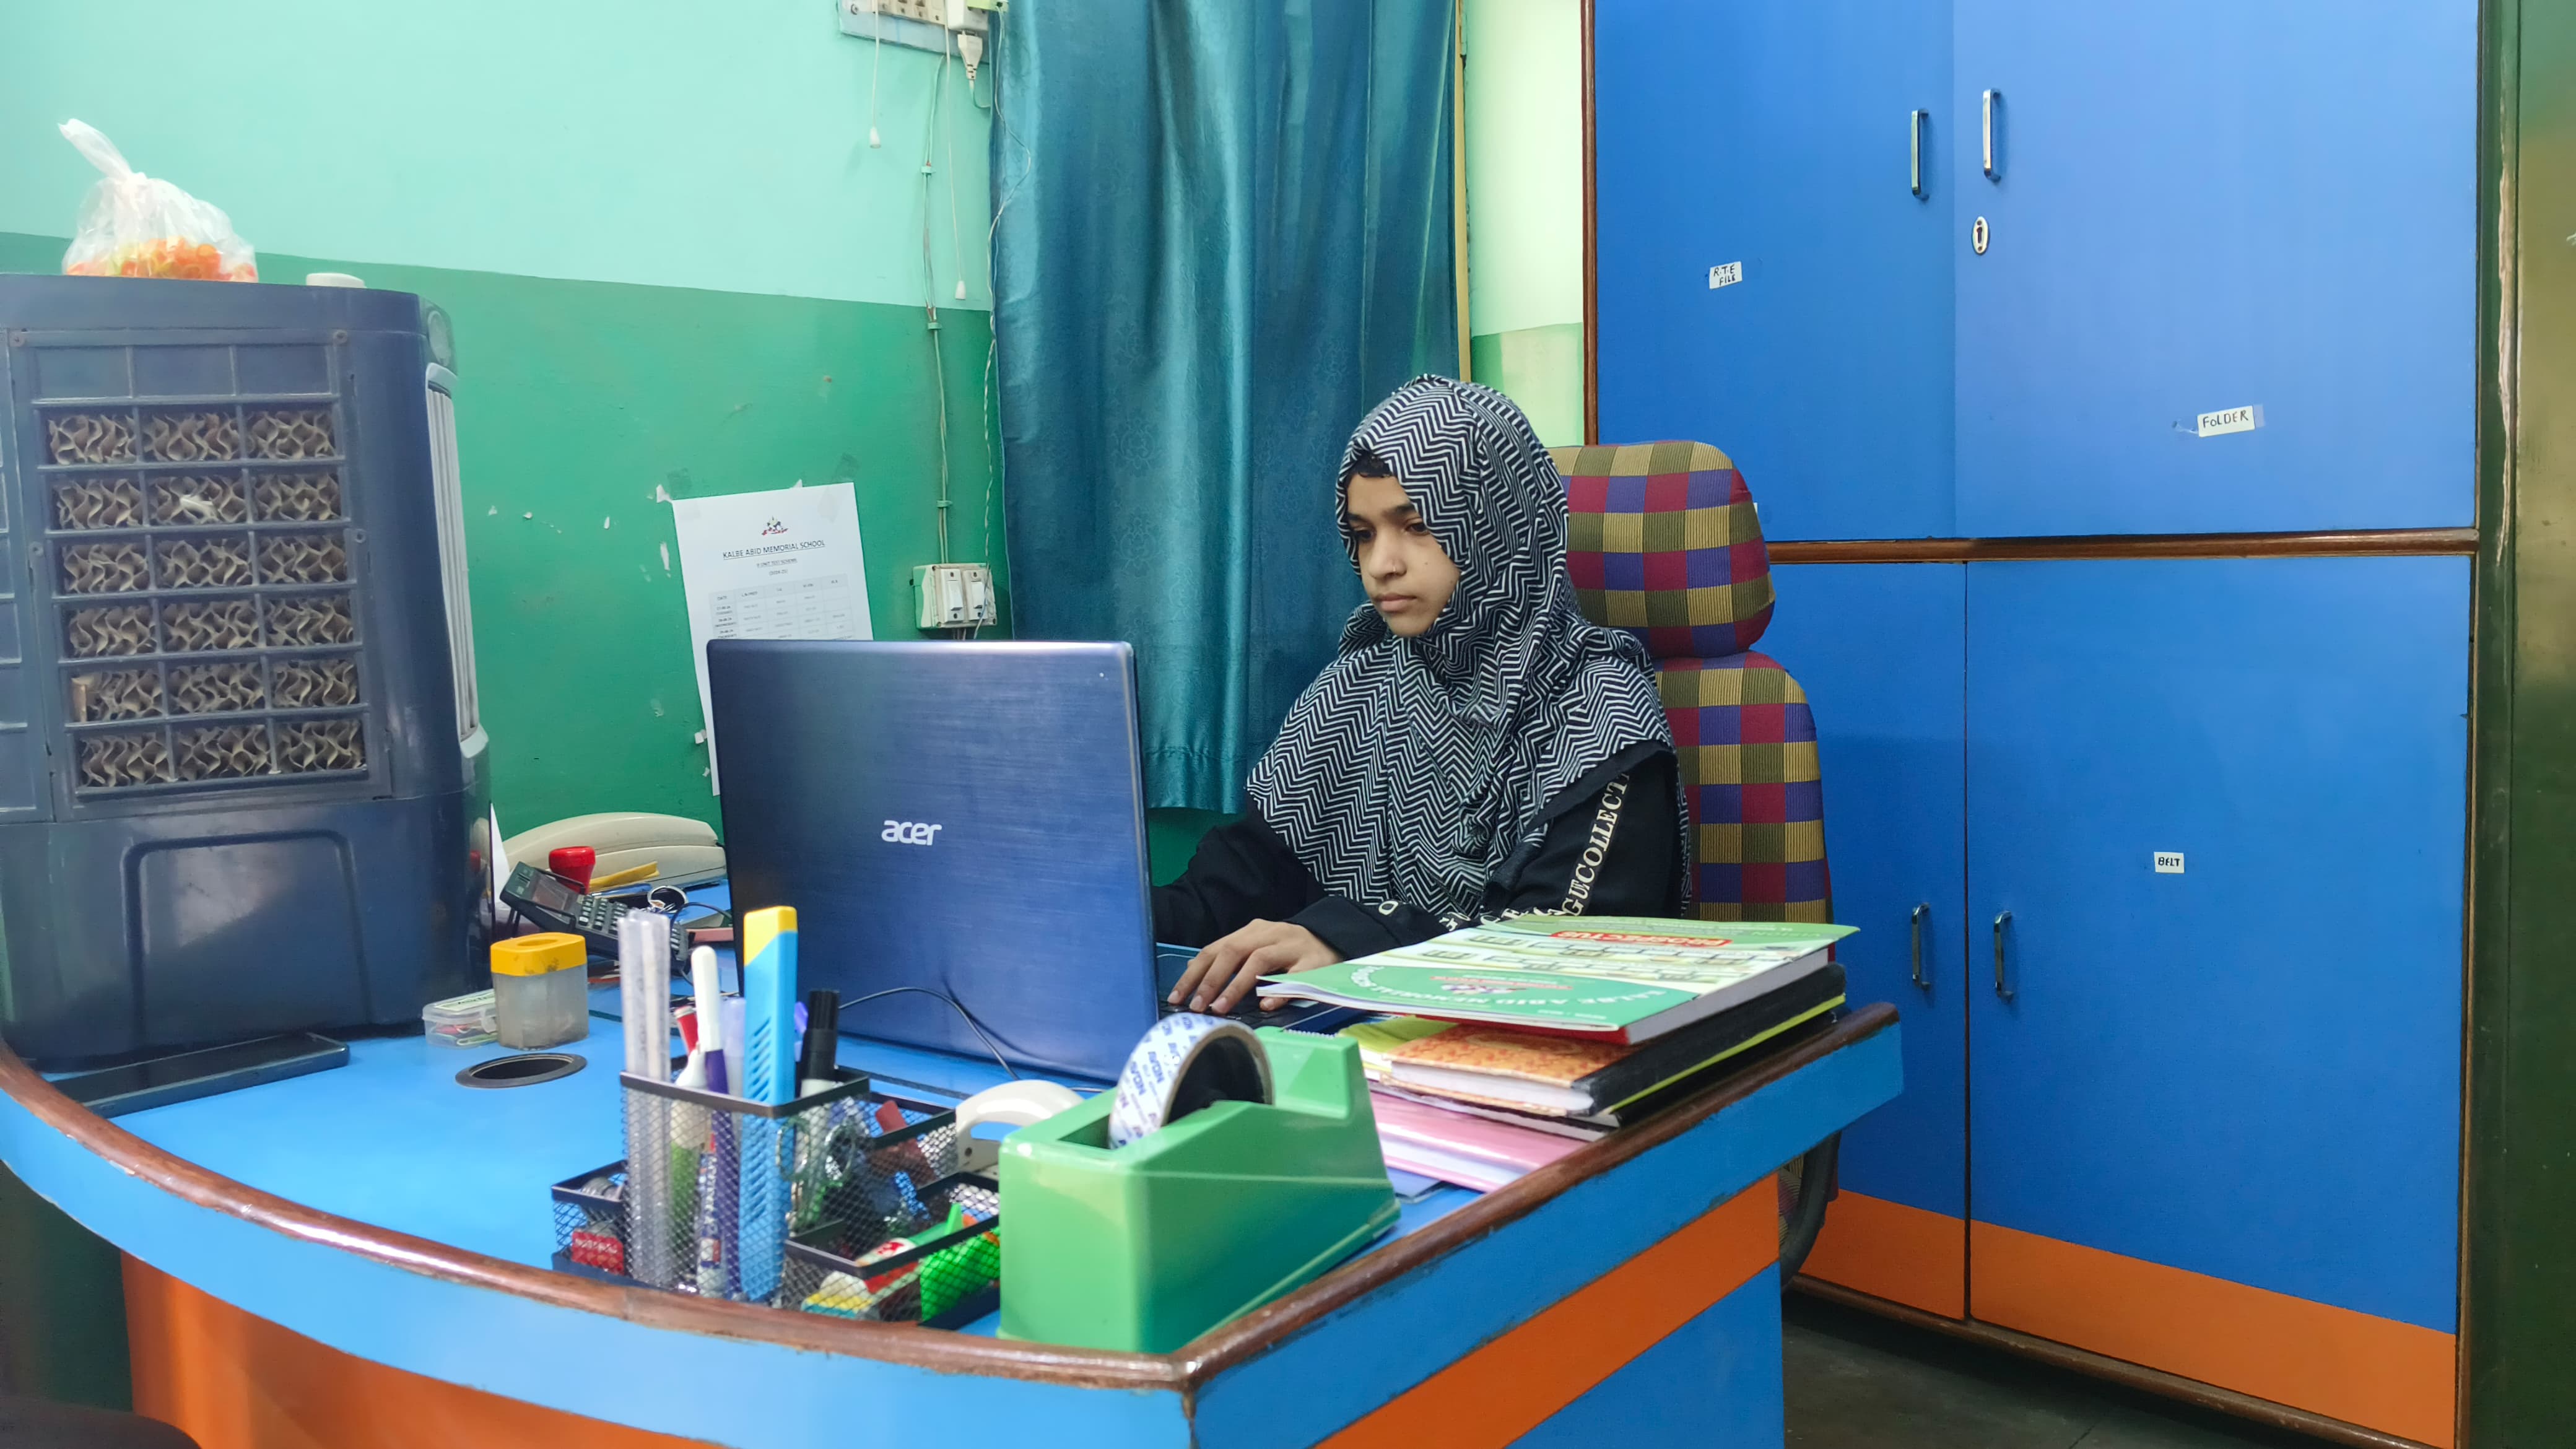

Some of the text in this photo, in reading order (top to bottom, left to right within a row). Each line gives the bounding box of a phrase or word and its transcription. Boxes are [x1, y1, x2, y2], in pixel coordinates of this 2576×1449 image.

[723, 539, 825, 558] KALBE ABID MEMORIAL SCHOOL
[881, 820, 942, 845] acer
[2158, 856, 2180, 867] BELT
[1557, 931, 1725, 946] PROSPECTUS
